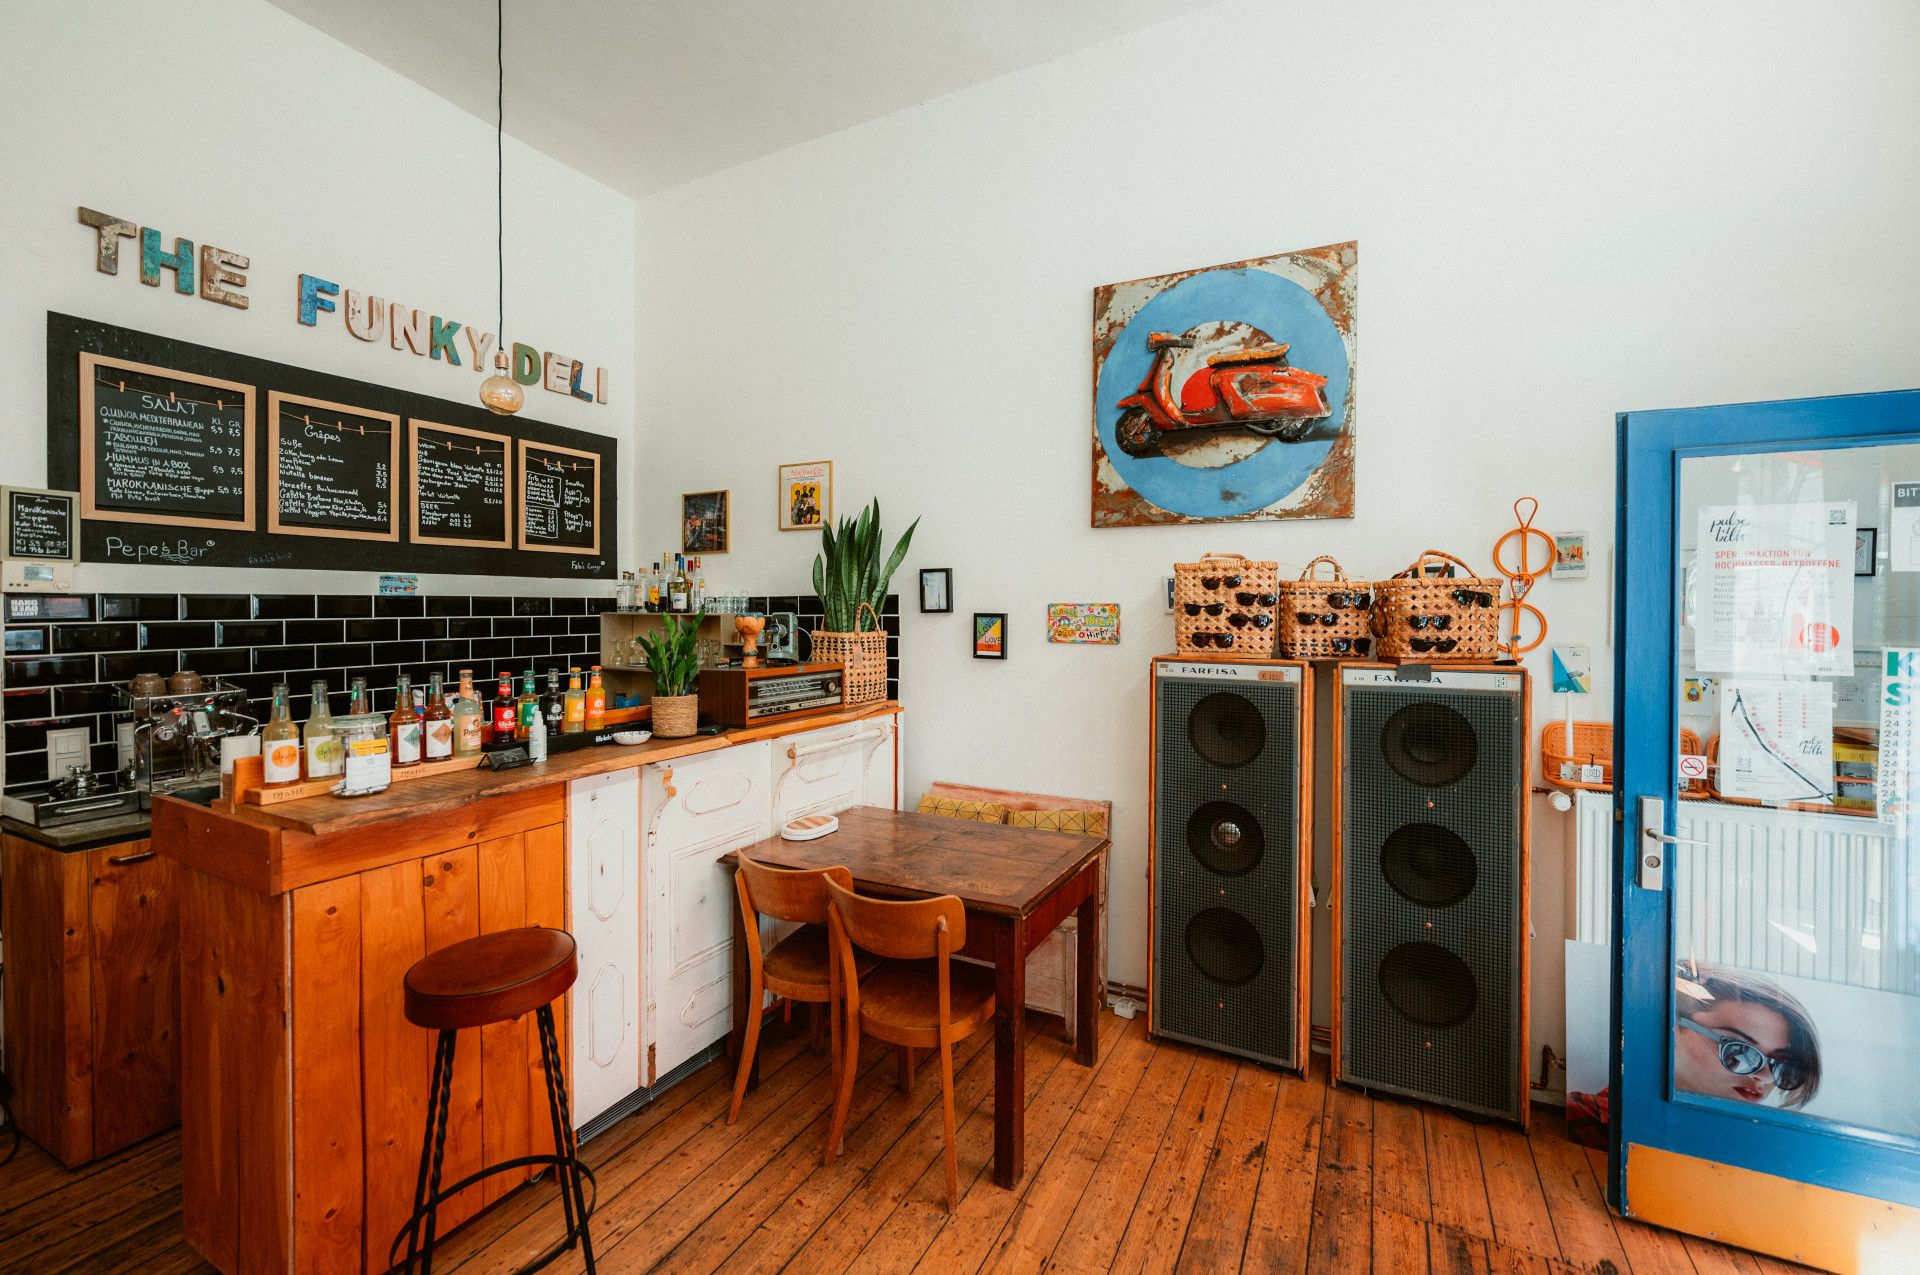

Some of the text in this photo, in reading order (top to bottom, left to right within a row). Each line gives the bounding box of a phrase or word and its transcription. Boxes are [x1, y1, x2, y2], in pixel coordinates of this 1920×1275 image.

[78, 206, 609, 404] THE FUNKY DELI
[142, 395, 198, 414] SALAT
[100, 406, 138, 420] QUINOA
[139, 413, 204, 429] MEDITERRANEAN
[211, 426, 223, 434] 5,9
[229, 429, 240, 437] 7,5
[305, 425, 340, 444] Crêpes
[210, 446, 223, 454] 5,9
[228, 447, 240, 456] 7,5
[105, 452, 149, 465] HUMMUS
[171, 460, 190, 469] BOX
[213, 466, 224, 474] 5,9
[231, 467, 243, 475] 7,5
[280, 470, 305, 478] Nutella
[107, 478, 191, 492] MAROKKANISCHE
[233, 487, 242, 495] 7,5
[1897, 487, 1920, 498] BIT
[20, 513, 48, 522] Suppe
[106, 536, 207, 562] Pepe's Bar
[1715, 550, 1789, 559] SPENNAKTION
[985, 635, 1001, 644] LOVE
[1182, 667, 1238, 675] FARFISA
